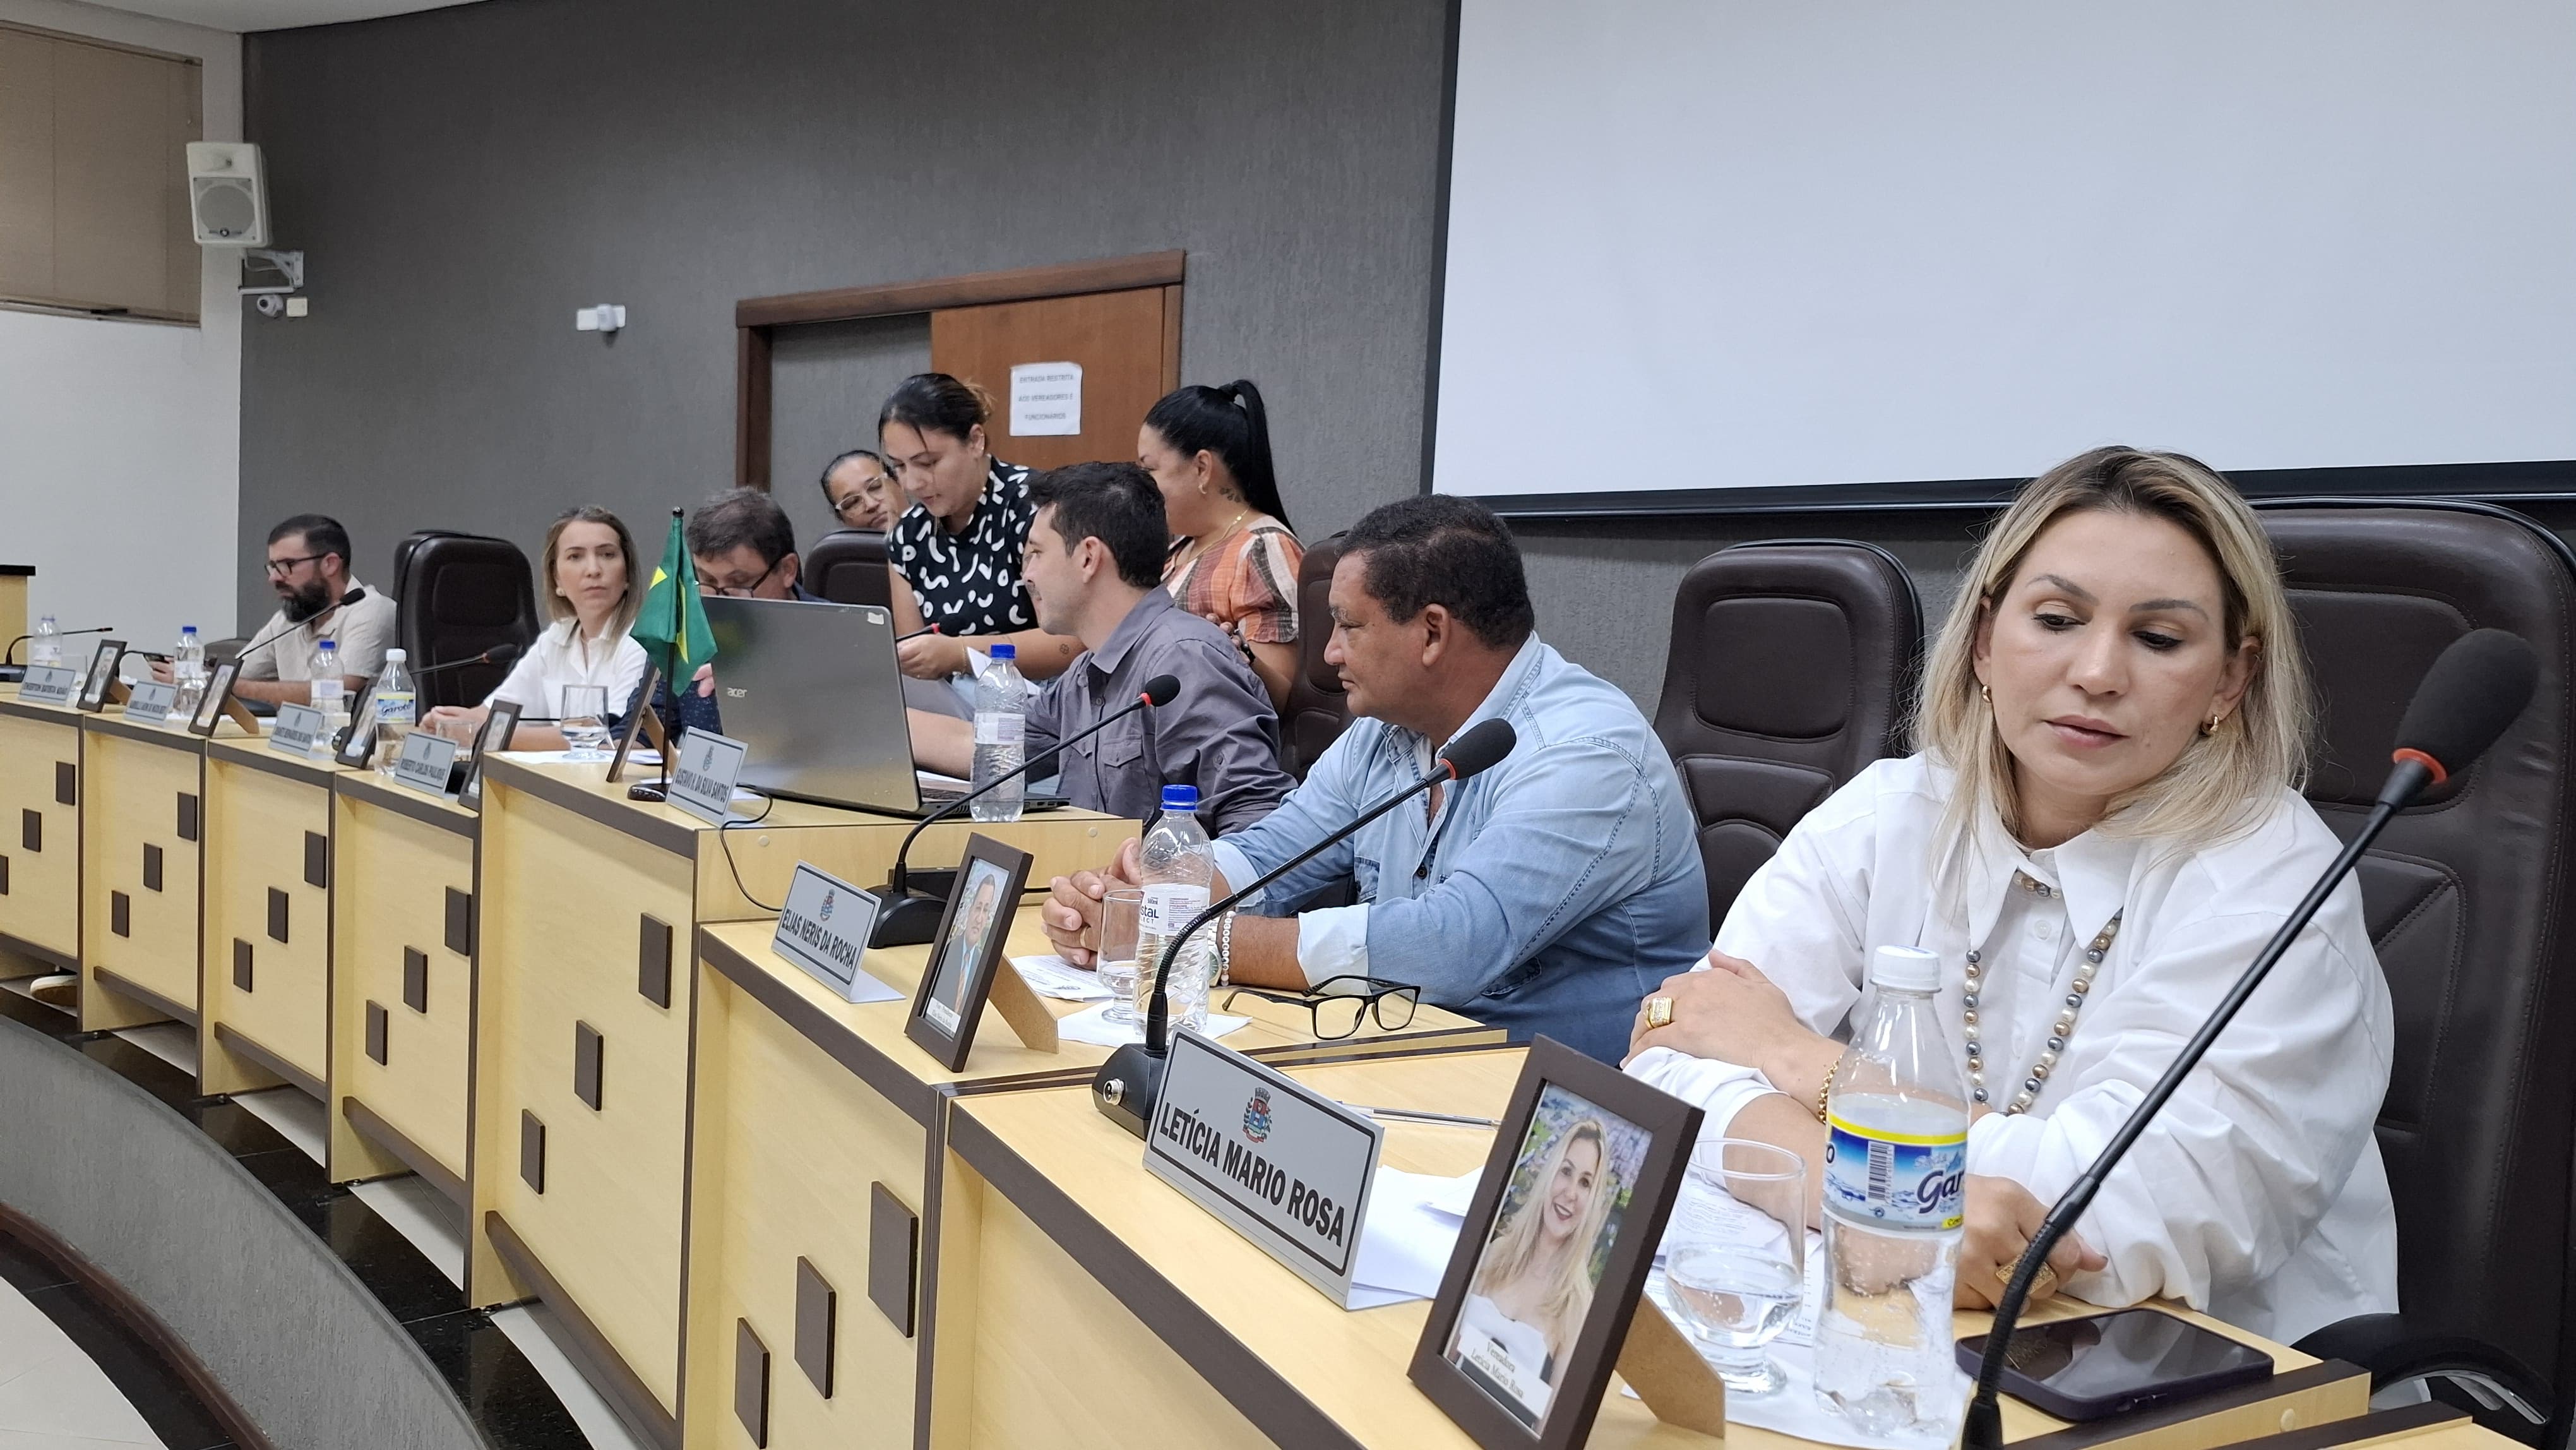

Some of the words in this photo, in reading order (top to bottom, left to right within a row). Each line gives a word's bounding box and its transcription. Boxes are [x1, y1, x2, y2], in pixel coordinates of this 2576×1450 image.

[1032, 393, 1068, 402] VEREADORES
[727, 686, 748, 698] acer
[700, 777, 715, 797] SILVA
[711, 781, 730, 804] SANTOS
[781, 908, 803, 937] ELIAS
[799, 918, 823, 948] NERIS
[819, 929, 833, 955] DA
[829, 935, 857, 971] ROCHA
[1159, 1102, 1222, 1168] LETÍCIA
[1222, 1138, 1286, 1206] MARIO
[1286, 1177, 1345, 1249] ROSA
[1487, 1341, 1516, 1374] Vereadora
